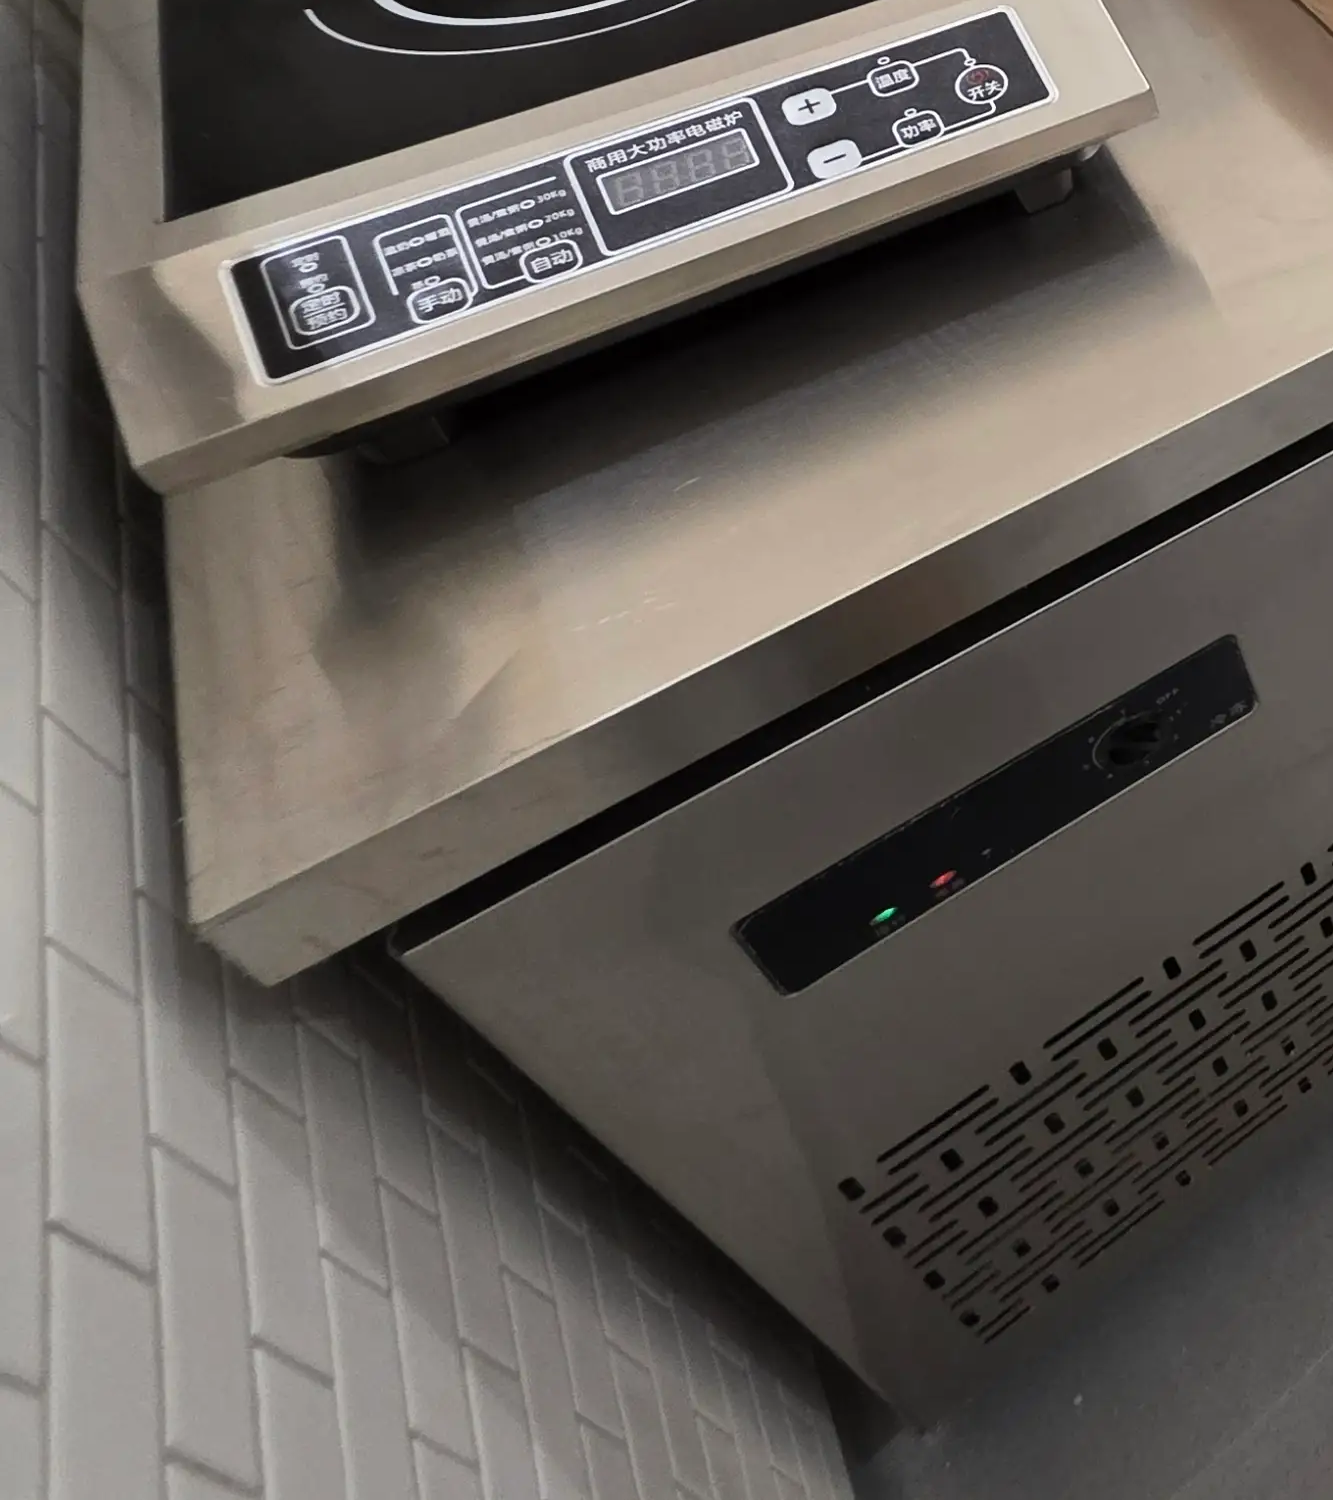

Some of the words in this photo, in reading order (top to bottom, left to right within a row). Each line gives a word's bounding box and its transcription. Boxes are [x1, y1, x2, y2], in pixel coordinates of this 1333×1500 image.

[874, 68, 913, 90] 温度
[967, 80, 1002, 100] 开关
[900, 118, 937, 139] 功率
[584, 110, 743, 173] 商用大功率电磁炉
[530, 249, 574, 274] 自动
[418, 288, 463, 312] 手动
